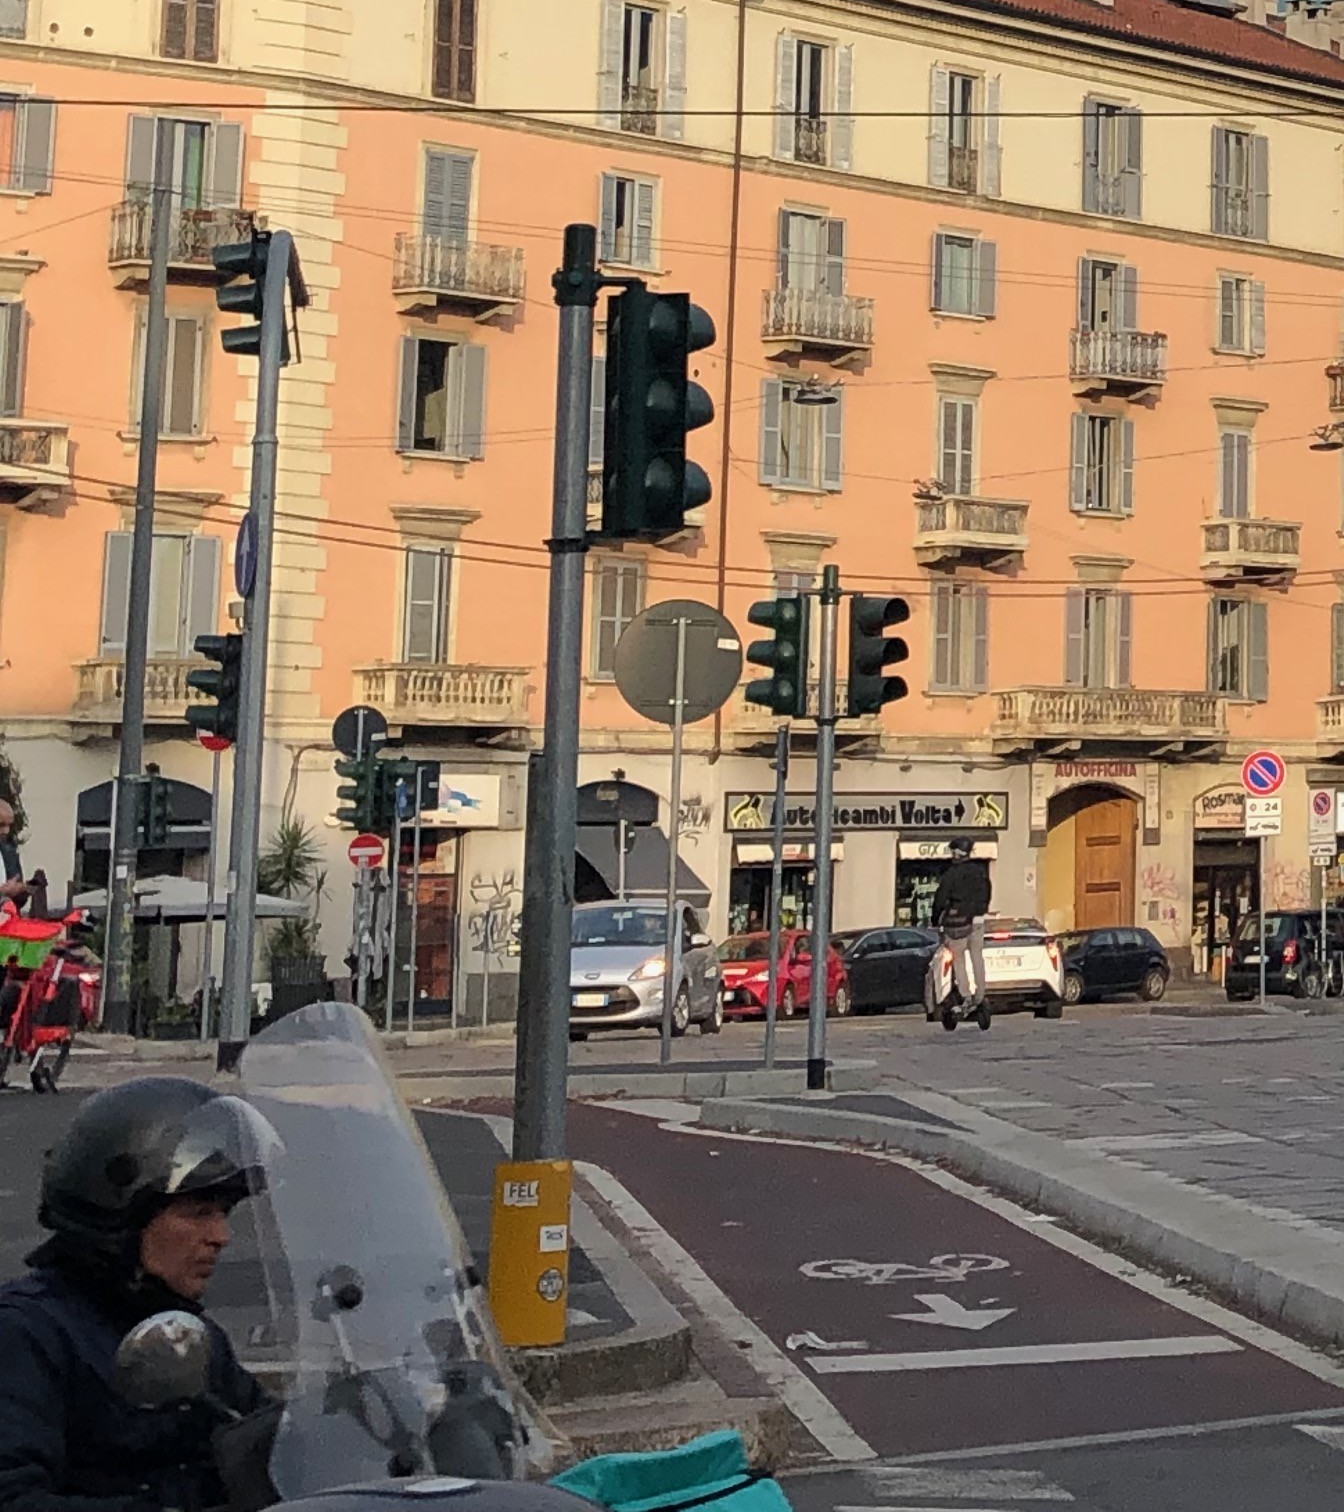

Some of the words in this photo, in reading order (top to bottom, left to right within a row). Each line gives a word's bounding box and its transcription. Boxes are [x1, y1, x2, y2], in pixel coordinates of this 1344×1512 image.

[1054, 762, 1137, 778] AUTOFFICINA
[899, 800, 952, 826] Volta
[1264, 802, 1278, 812] 24
[509, 1183, 535, 1198] FEL
